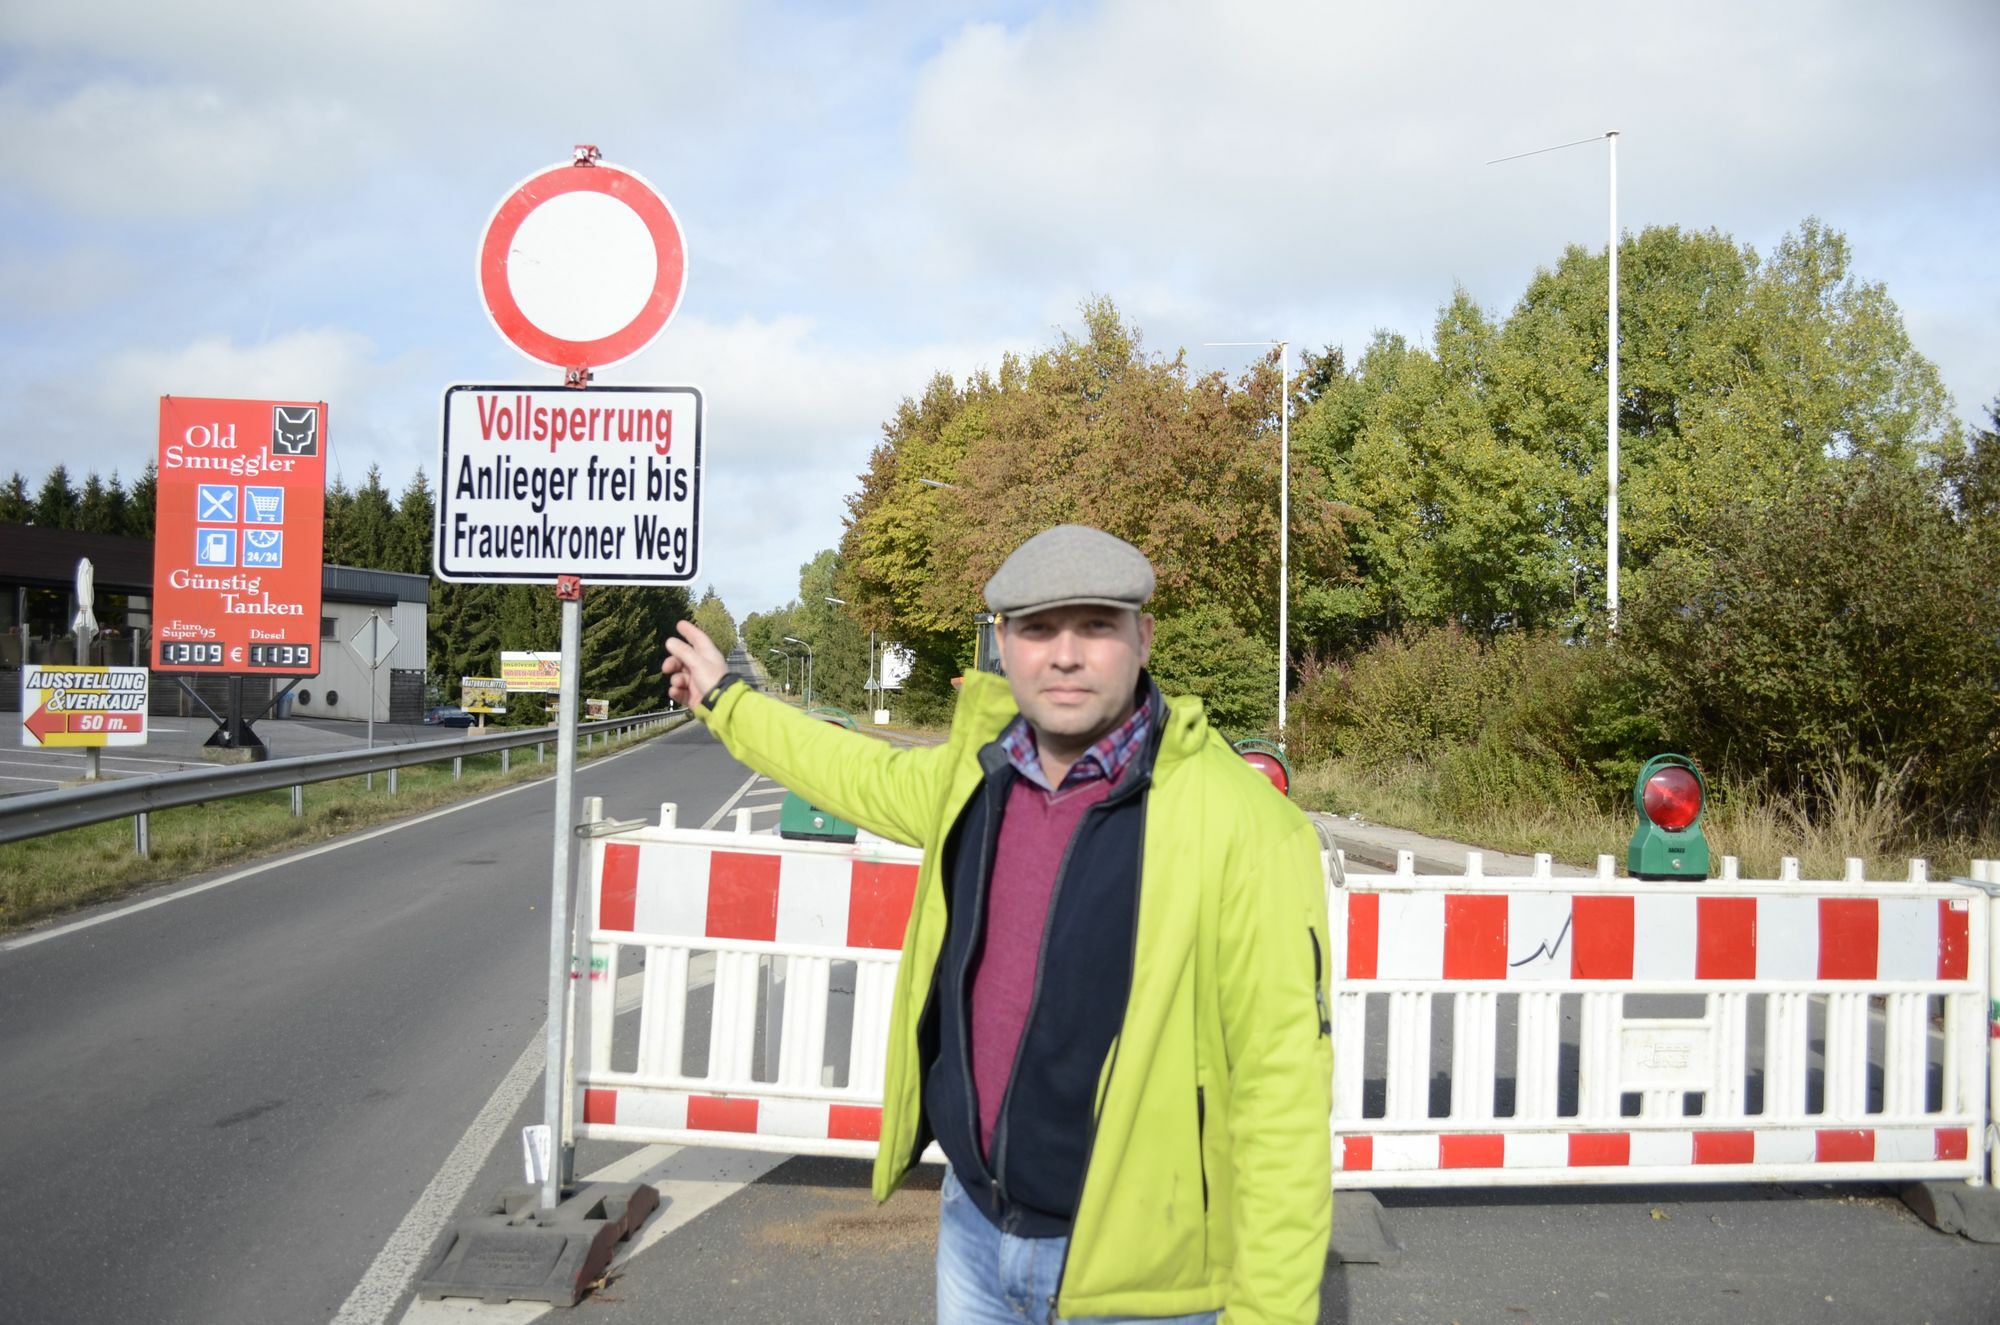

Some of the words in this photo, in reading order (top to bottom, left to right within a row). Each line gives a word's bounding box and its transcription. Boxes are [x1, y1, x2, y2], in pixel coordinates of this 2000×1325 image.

[477, 395, 672, 455] Vollsperrung
[185, 423, 238, 449] Old
[165, 445, 296, 477] Smuggler
[456, 455, 578, 513] Anlieger
[587, 455, 635, 501] frei
[647, 456, 688, 501] bis
[454, 513, 626, 559] Frauenkroner
[634, 514, 687, 573] Weg
[247, 552, 278, 563] 24/24
[170, 569, 262, 595] Günstig
[220, 592, 304, 615] Tanken
[162, 627, 198, 639] Super
[172, 620, 202, 631] Euro
[251, 629, 285, 640] Diesel
[230, 647, 243, 663] €
[27, 671, 146, 690] AUSSTELLUNG
[81, 714, 104, 730] 50
[108, 718, 128, 730] m.
